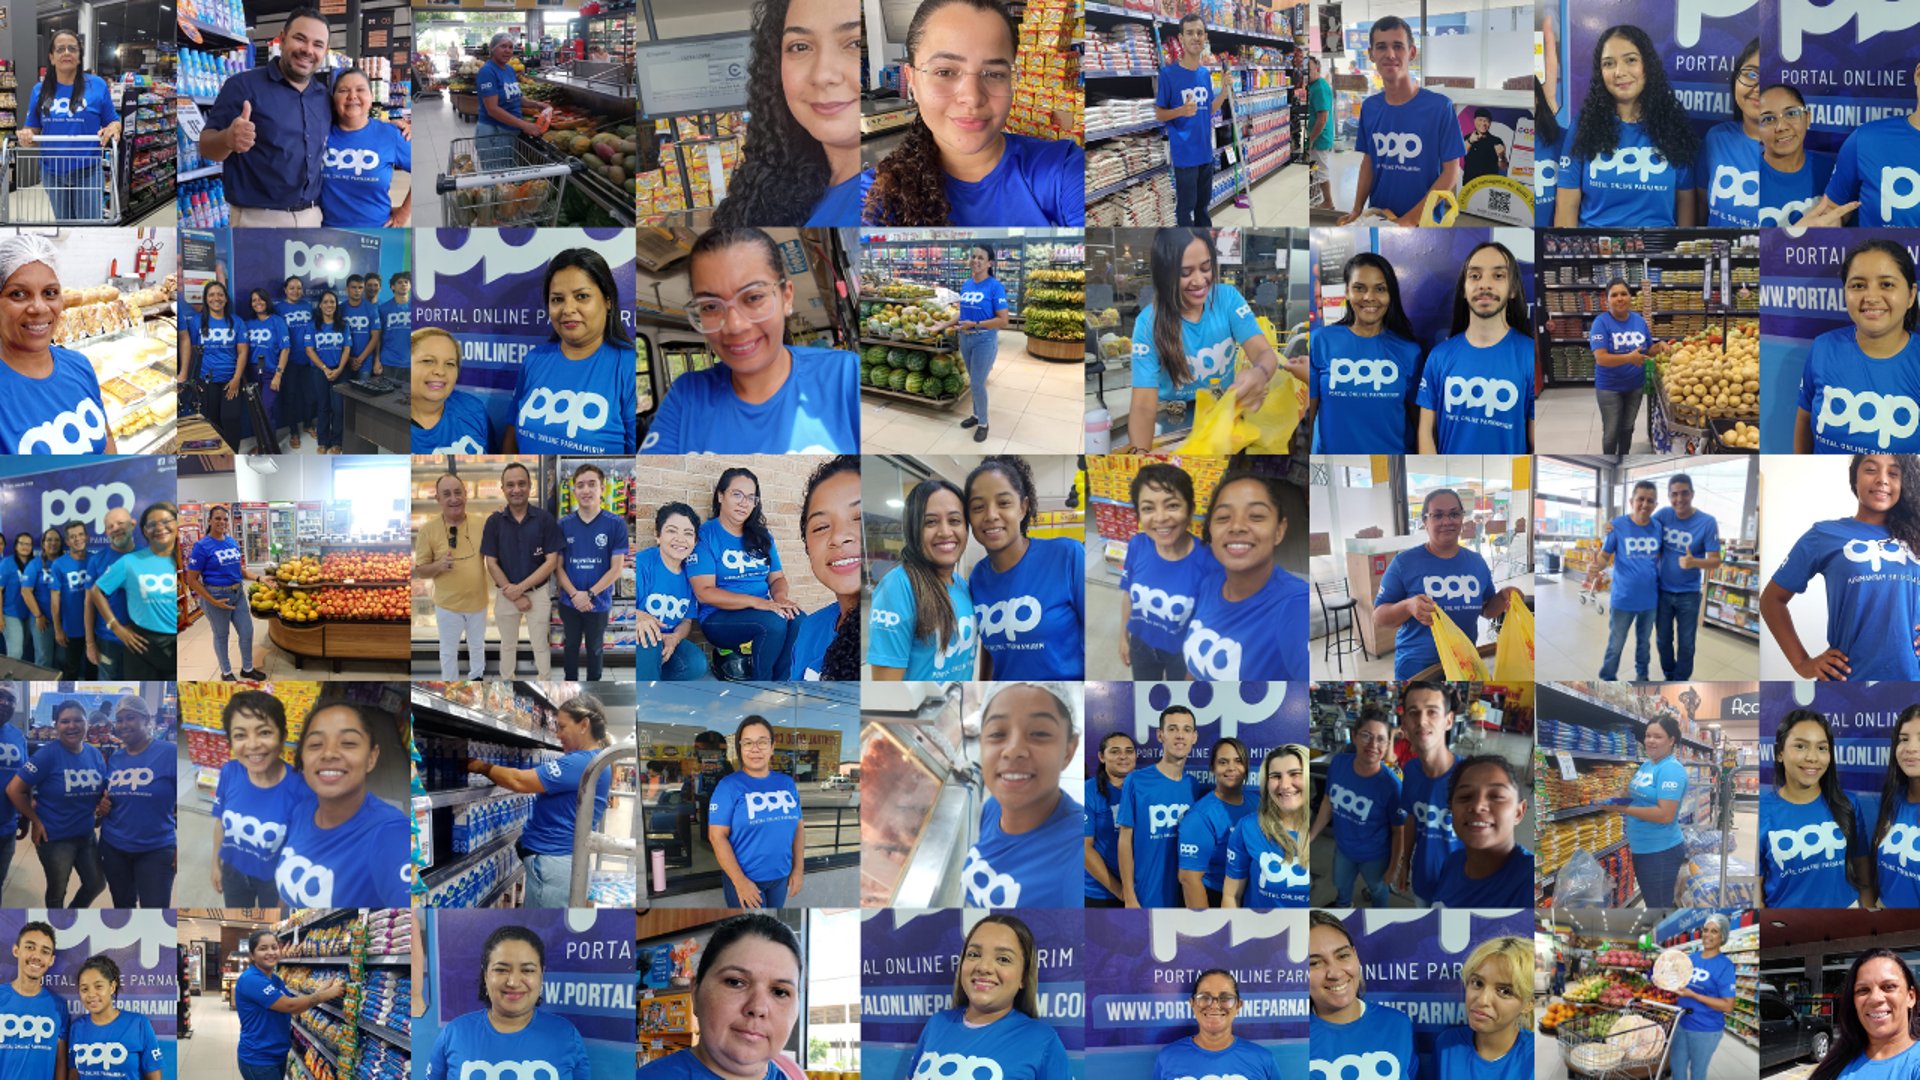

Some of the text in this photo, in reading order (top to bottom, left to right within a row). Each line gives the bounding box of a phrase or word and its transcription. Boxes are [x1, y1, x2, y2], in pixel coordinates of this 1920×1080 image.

[1781, 69, 1907, 87] PORTAL ONLINE
[1589, 146, 1669, 183] pop
[284, 239, 352, 287] pop
[416, 307, 467, 324] PORTAL
[473, 308, 530, 325] ONLINE
[314, 331, 344, 349] pop
[1611, 331, 1647, 349] pop
[1328, 358, 1399, 391] pop
[1443, 375, 1519, 418] pop
[518, 386, 609, 439] pop
[1815, 384, 1919, 450] pop
[41, 481, 136, 535] pop
[214, 547, 241, 566] pop
[1624, 536, 1659, 554] pop
[1423, 575, 1480, 604] pop
[869, 608, 900, 628] pop
[1136, 748, 1210, 759] PORTA LINE
[64, 768, 102, 793] pop
[107, 767, 154, 792] pop
[1661, 780, 1679, 790] pop
[745, 789, 798, 820] pop
[1180, 843, 1199, 855] pop
[1767, 821, 1848, 870] pop
[1258, 851, 1310, 890] po
[566, 940, 631, 960] PORTA
[885, 954, 944, 975] ONLINE
[0, 1013, 55, 1044] pop
[73, 1042, 128, 1071] pop
